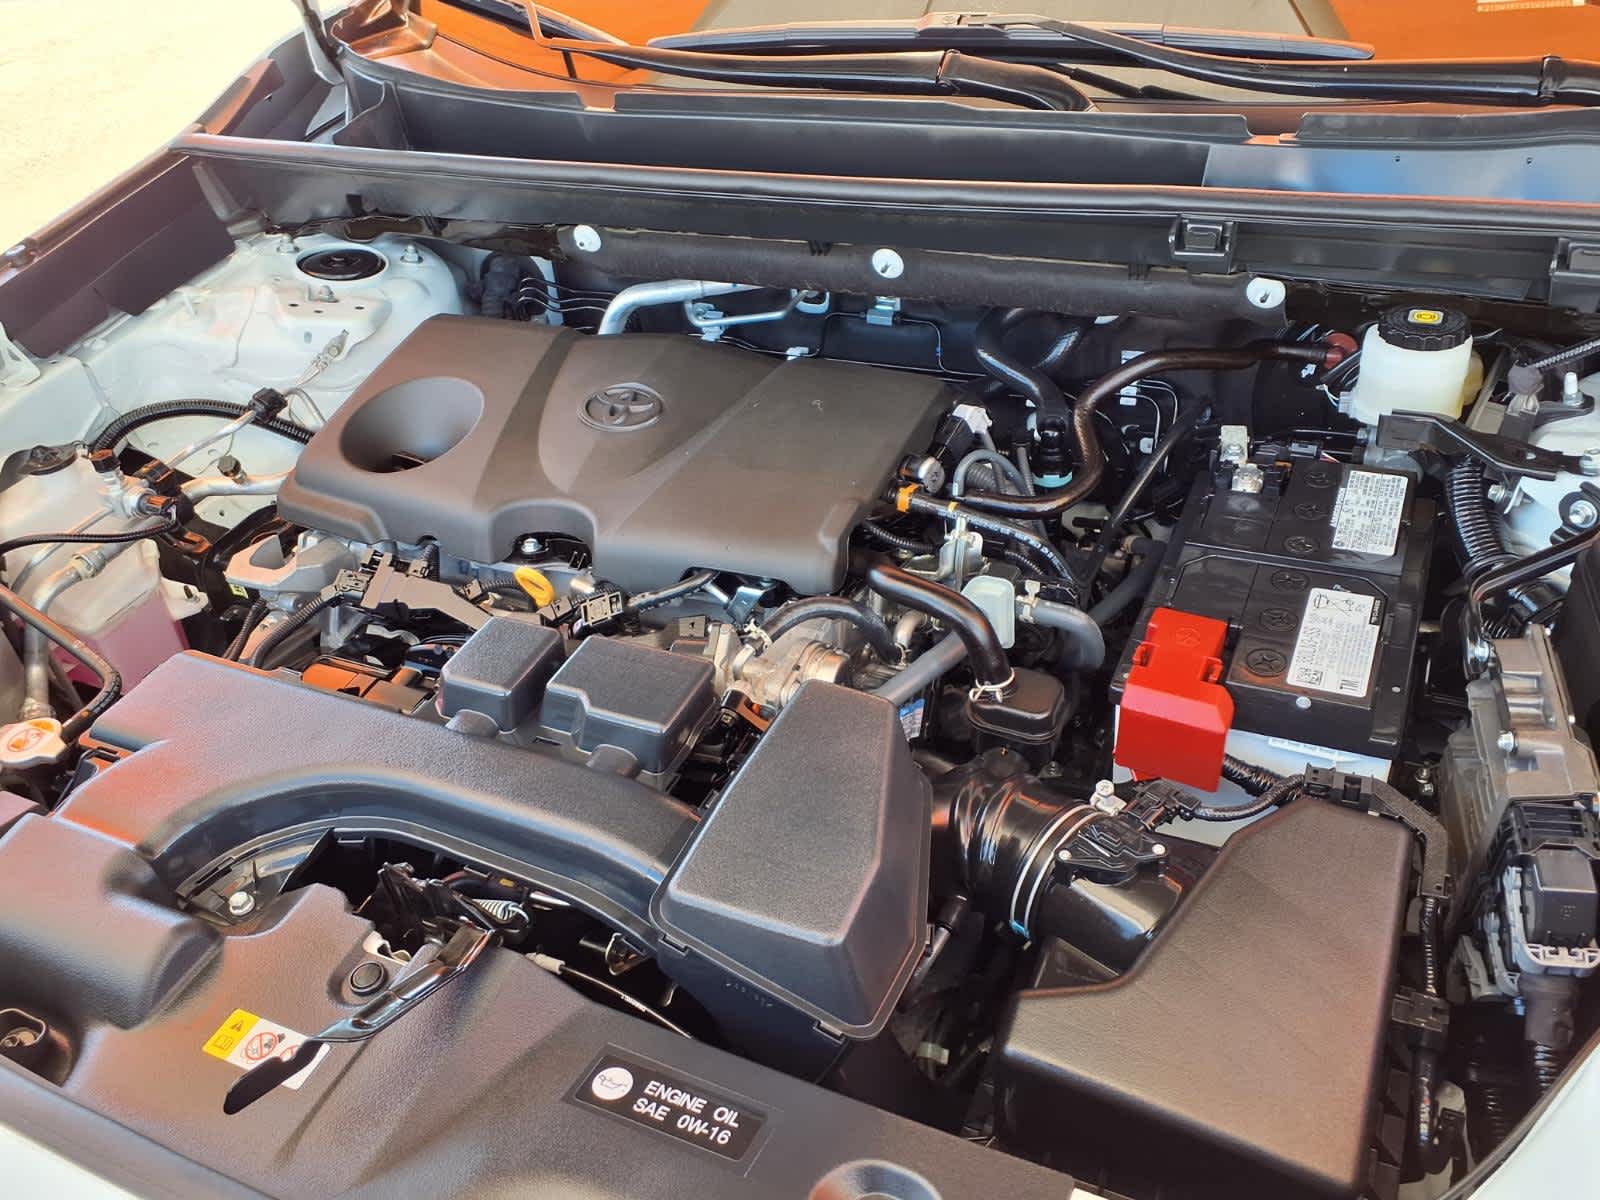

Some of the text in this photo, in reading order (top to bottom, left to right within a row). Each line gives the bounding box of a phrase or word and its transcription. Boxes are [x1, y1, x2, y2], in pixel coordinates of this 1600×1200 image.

[632, 1098, 731, 1145] SAE 0W-16
[643, 1080, 740, 1128] ENGINE OIL
